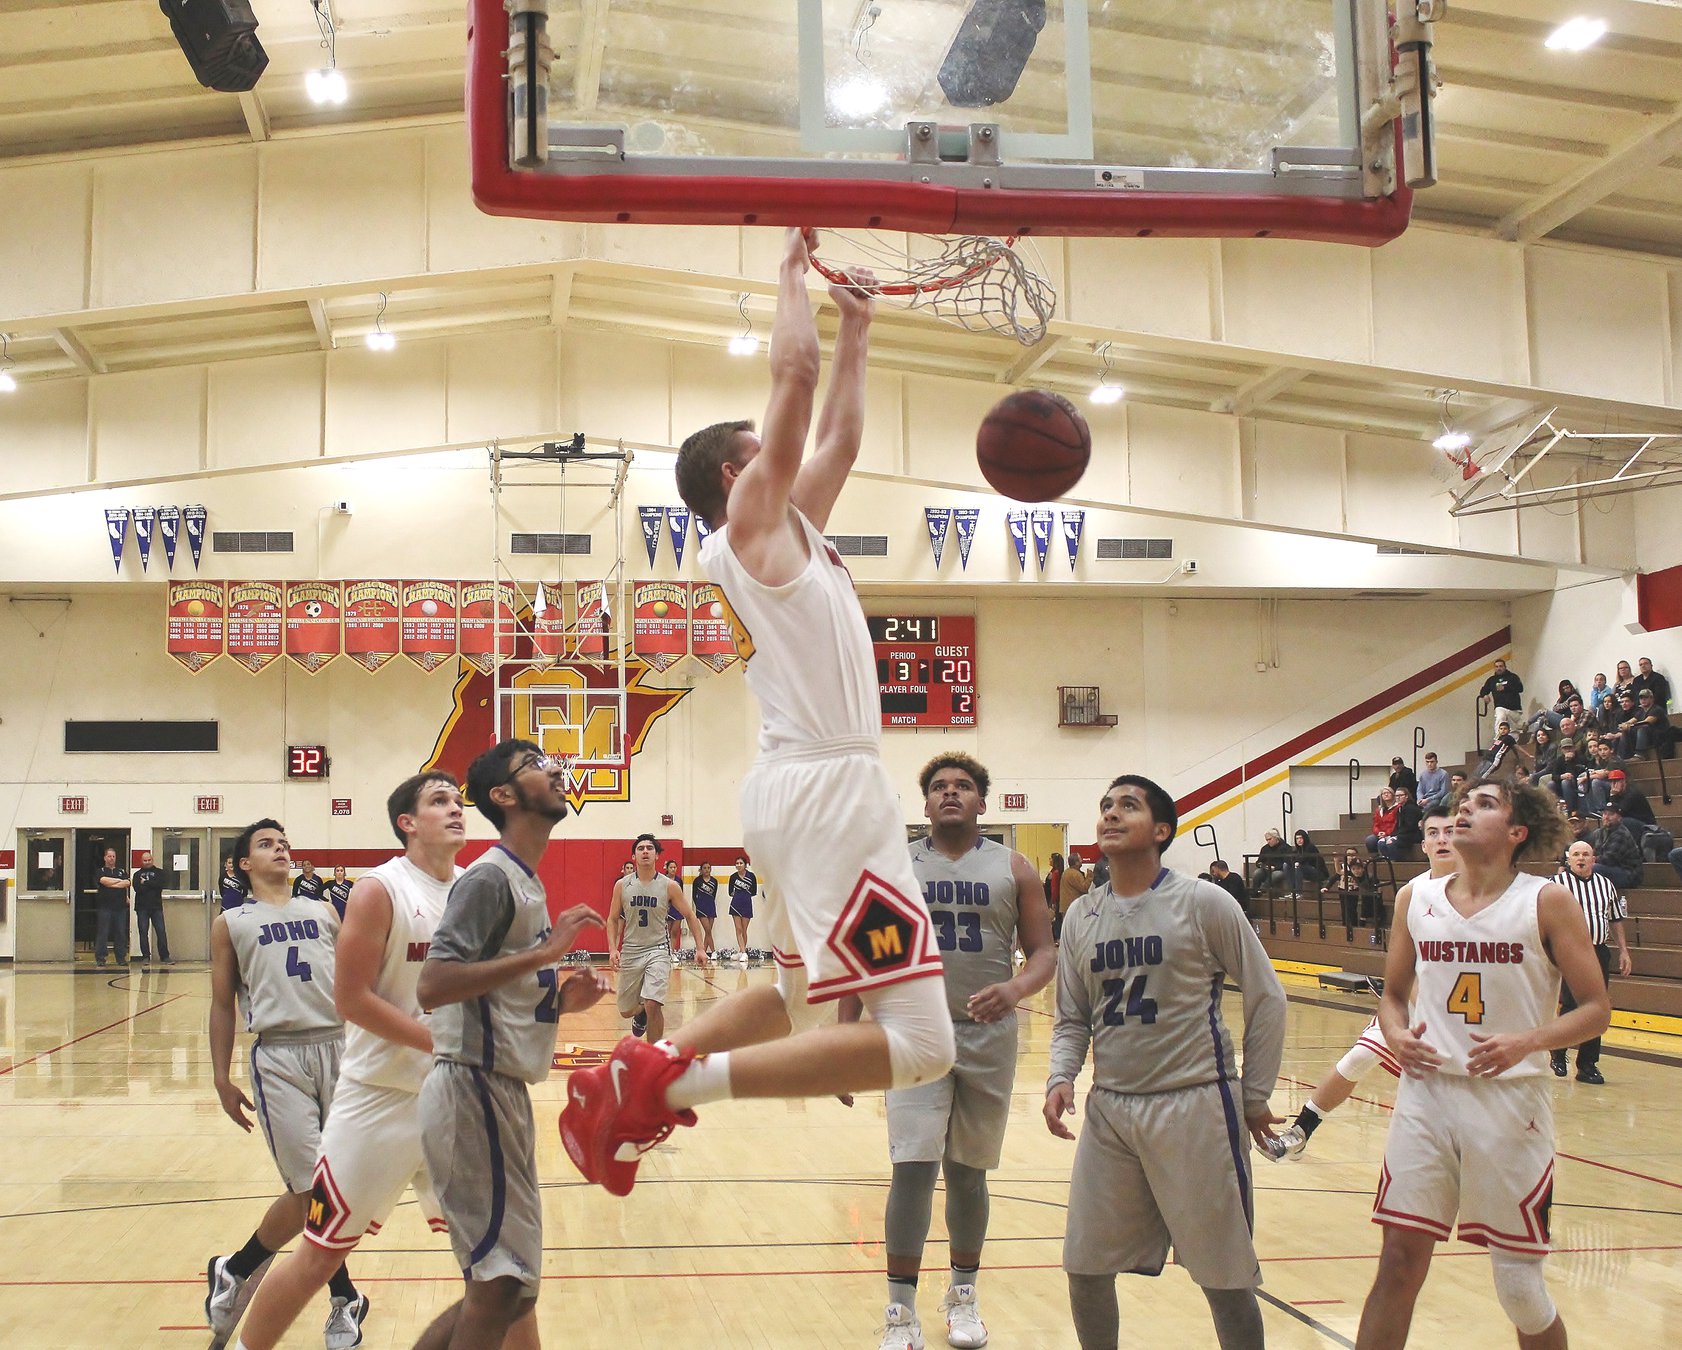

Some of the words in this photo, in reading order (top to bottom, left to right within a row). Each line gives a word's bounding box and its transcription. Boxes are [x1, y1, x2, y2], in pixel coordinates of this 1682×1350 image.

[403, 586, 456, 609] CHAMPIONS
[635, 587, 687, 609] CHAMPIONS
[885, 618, 936, 641] 2:41
[890, 652, 916, 660] PERIOD
[935, 646, 969, 657] GUEST
[898, 662, 909, 681] 3
[942, 660, 971, 683] 20
[880, 685, 907, 694] PLAYER
[910, 685, 928, 694] FOUL
[950, 685, 974, 694] FOULS
[960, 694, 971, 712] 2
[891, 716, 917, 724] MATCH
[950, 716, 974, 724] SCORE
[292, 750, 320, 773] 32
[65, 799, 82, 810] EXIT
[200, 799, 217, 810] EXIT
[1007, 795, 1023, 807] EXIT
[630, 895, 658, 908] JOHO
[922, 880, 990, 906] JOHO
[638, 909, 649, 928] 3
[258, 919, 320, 946] JOHO
[931, 910, 984, 952] 33
[866, 924, 903, 961] M
[1418, 941, 1524, 964] MUSTANGS
[285, 945, 313, 983] 4
[1090, 935, 1163, 973] JOHO
[1102, 974, 1158, 1026] 24
[1447, 972, 1485, 1025] 4
[308, 1198, 324, 1226] M
